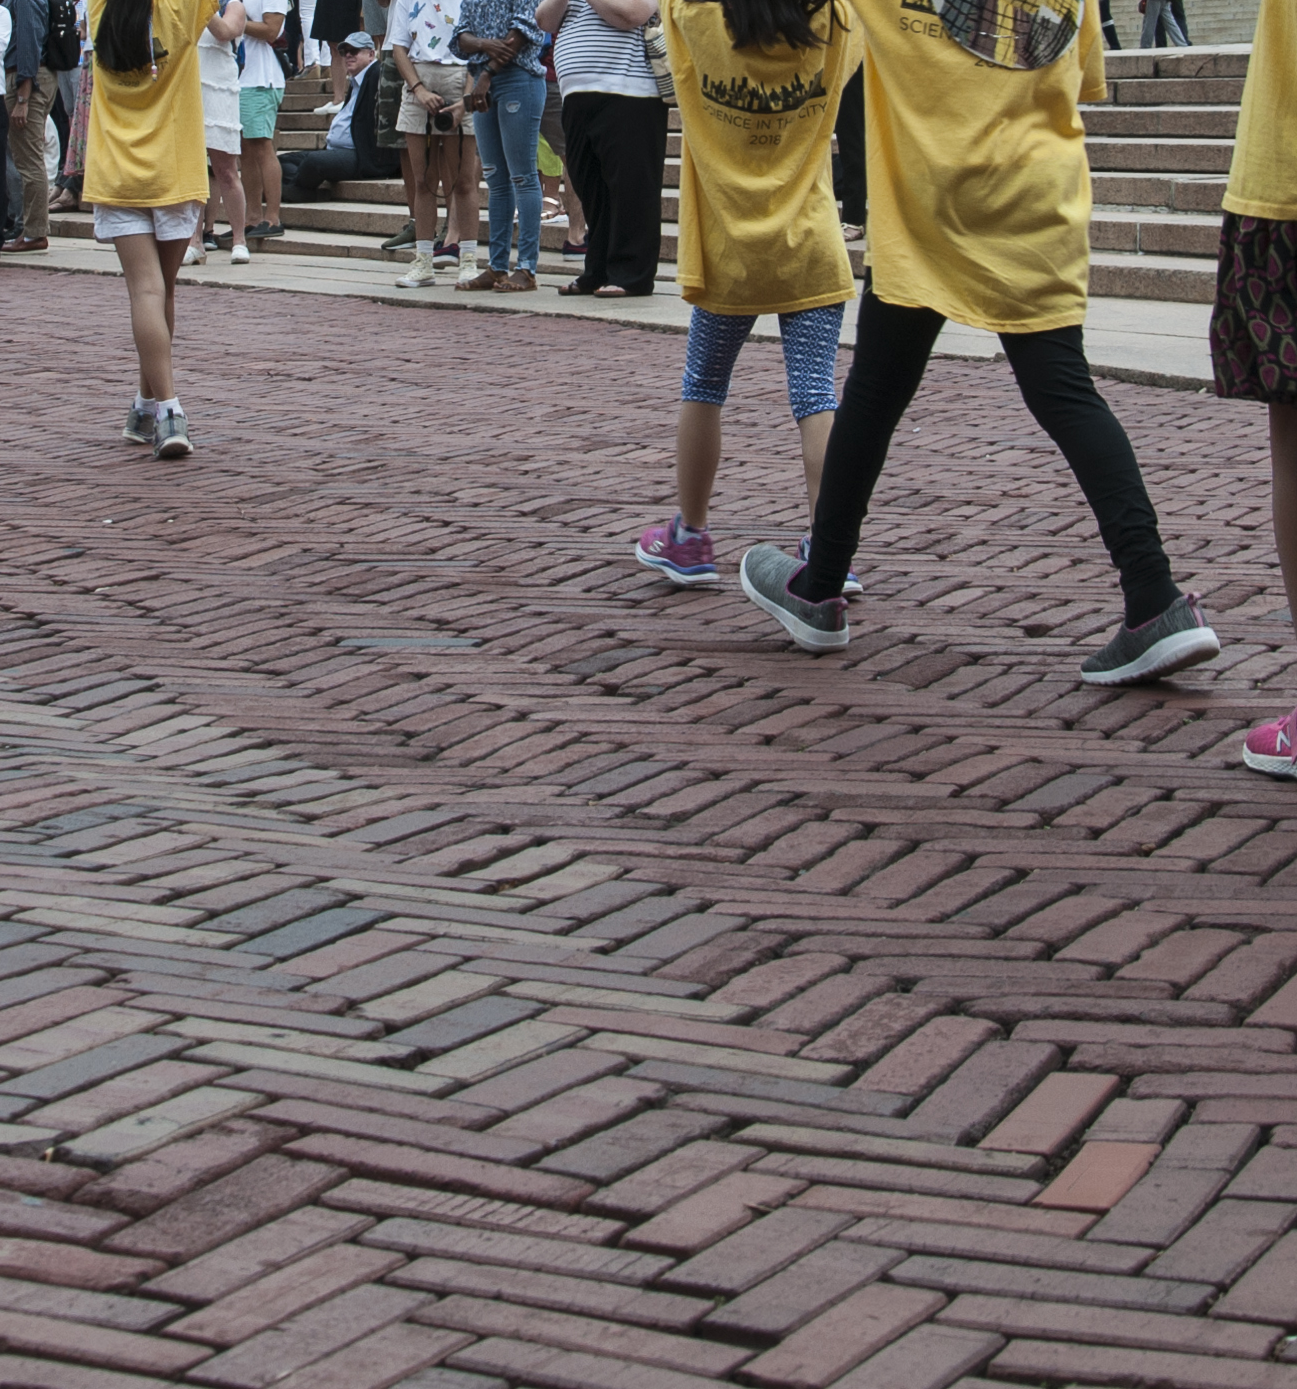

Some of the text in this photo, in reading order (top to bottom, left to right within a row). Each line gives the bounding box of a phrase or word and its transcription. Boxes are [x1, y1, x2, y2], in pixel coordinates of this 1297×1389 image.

[756, 119, 772, 131] IN
[798, 102, 828, 120] CITY
[749, 133, 783, 146] 2018
